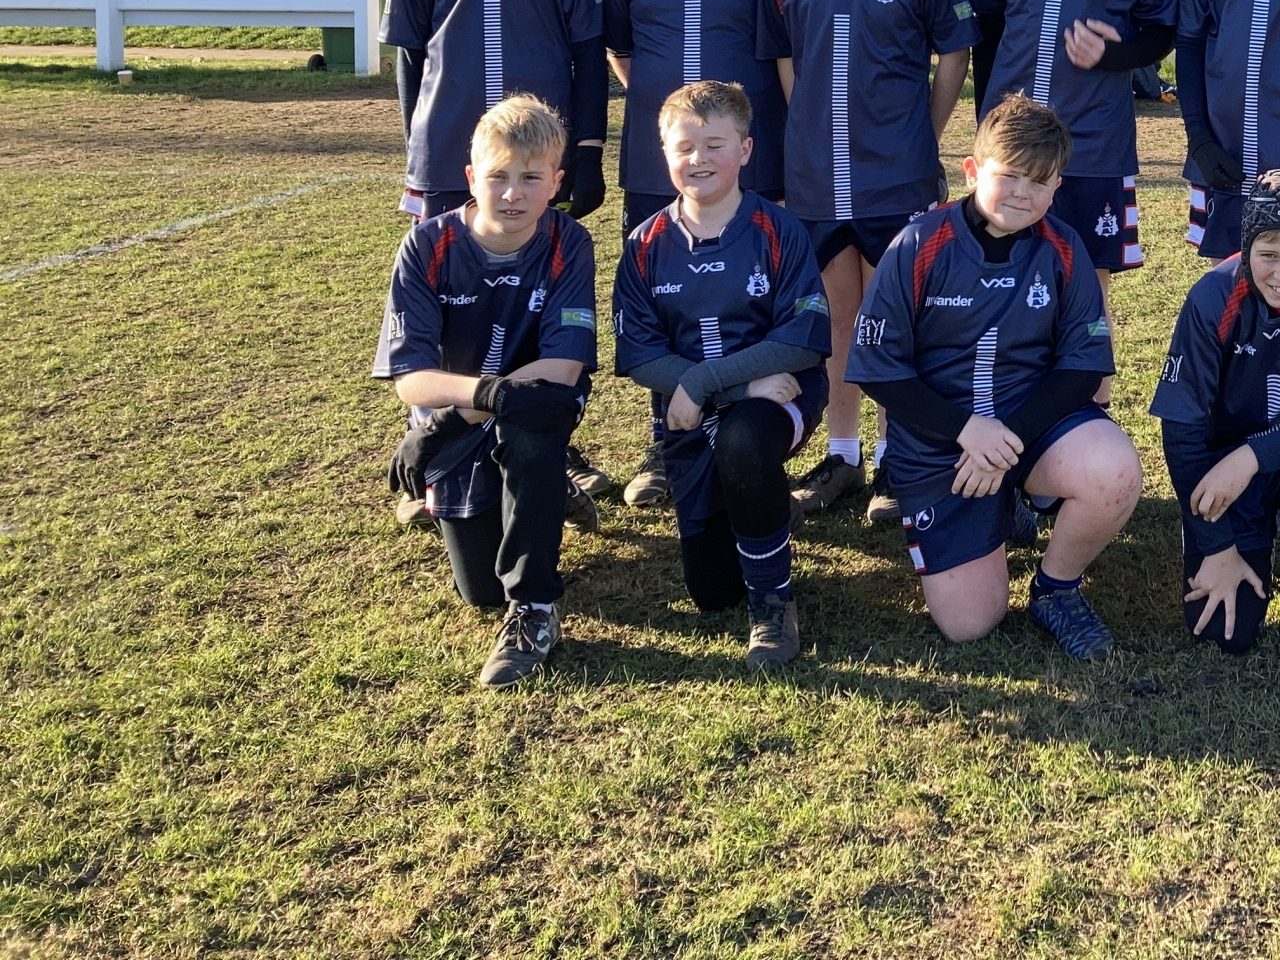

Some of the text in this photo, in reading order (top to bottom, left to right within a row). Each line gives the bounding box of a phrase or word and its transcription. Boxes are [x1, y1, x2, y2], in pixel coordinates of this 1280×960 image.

[688, 261, 726, 274] VX3
[483, 274, 521, 288] VX3
[980, 277, 1016, 289] VX3
